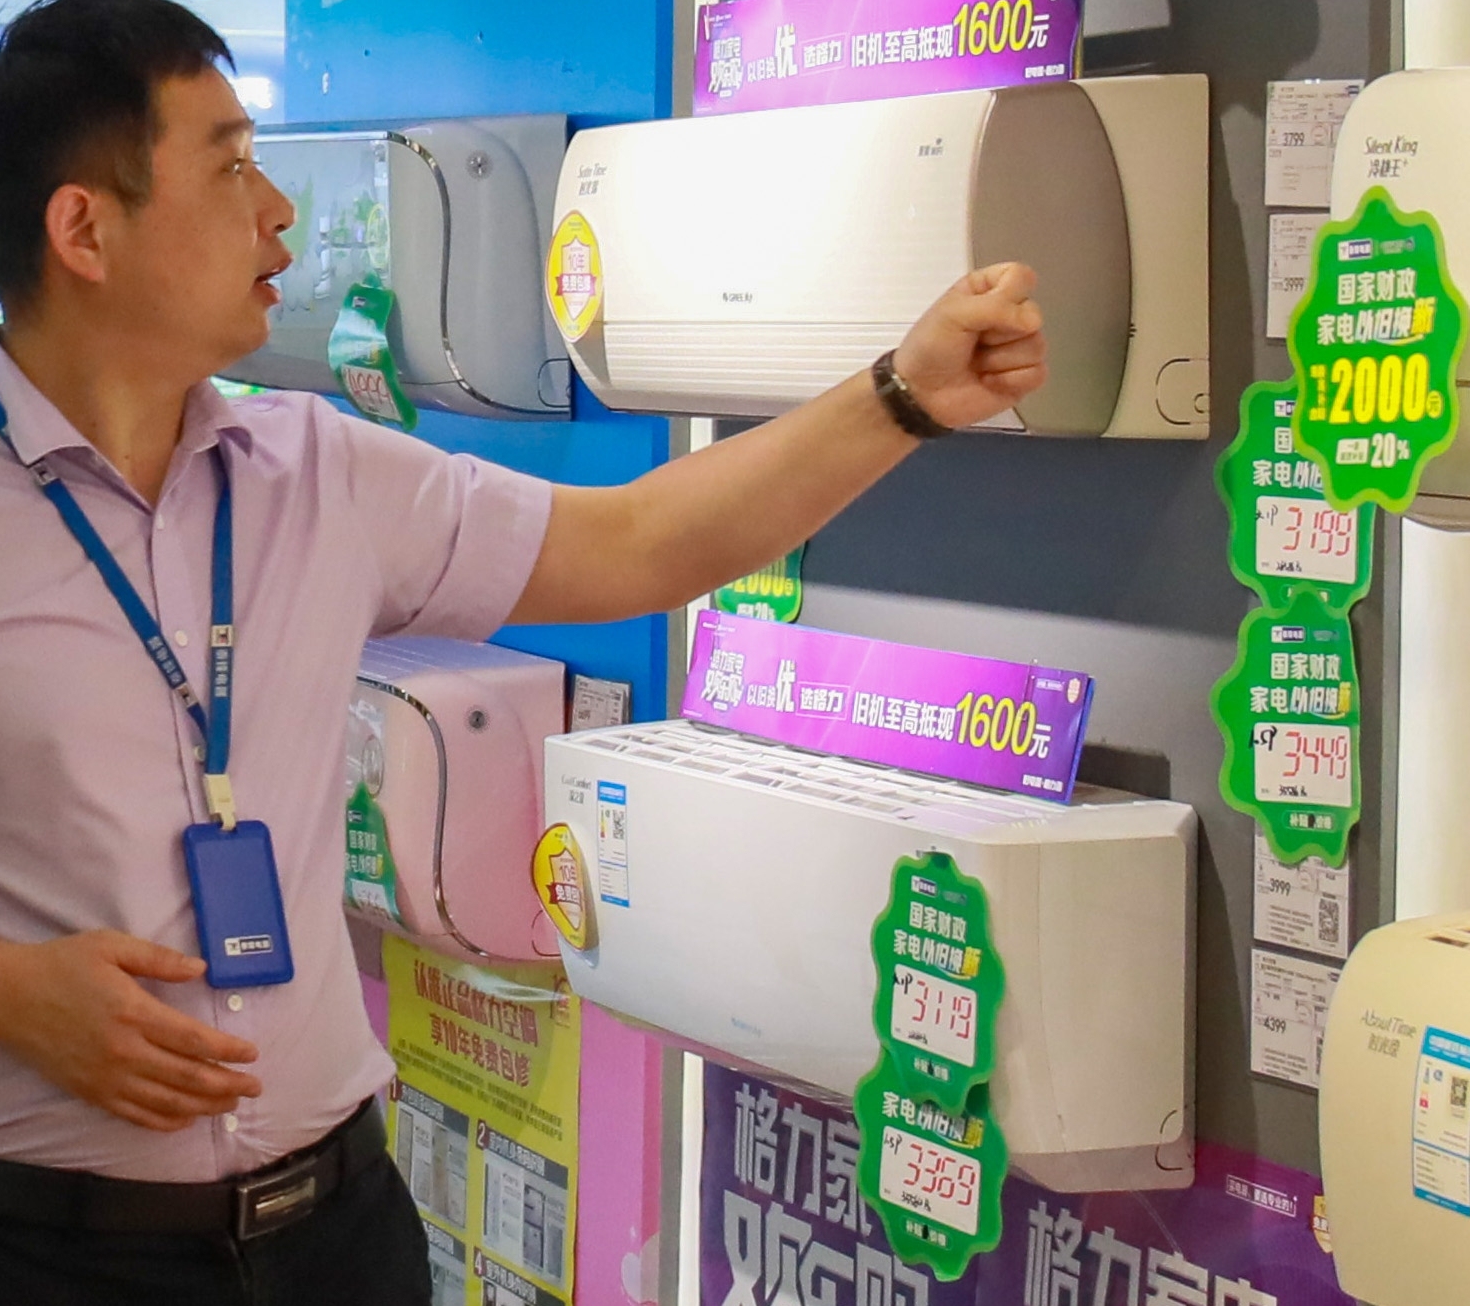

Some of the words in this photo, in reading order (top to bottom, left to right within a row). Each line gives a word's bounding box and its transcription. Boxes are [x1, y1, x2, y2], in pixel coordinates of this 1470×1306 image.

[1365, 137, 1393, 155] Silent
[1395, 135, 1417, 155] King
[1337, 269, 1416, 306] 国家财政
[1317, 297, 1436, 346] 家电以旧换新
[1371, 433, 1409, 468] 20%
[1282, 507, 1352, 557] 3199
[1270, 654, 1341, 681] 国家财政
[1250, 682, 1350, 716] 家电以旧换新
[852, 692, 1051, 759] 旧机至高抵现1600元
[1282, 732, 1348, 778] 3449
[1269, 878, 1290, 896] 3999
[909, 902, 967, 944] 国家财政
[893, 929, 981, 977] 家电以旧换新
[1264, 1016, 1286, 1033] 4399
[734, 1082, 872, 1236] 格力家
[904, 1143, 975, 1205] 3369
